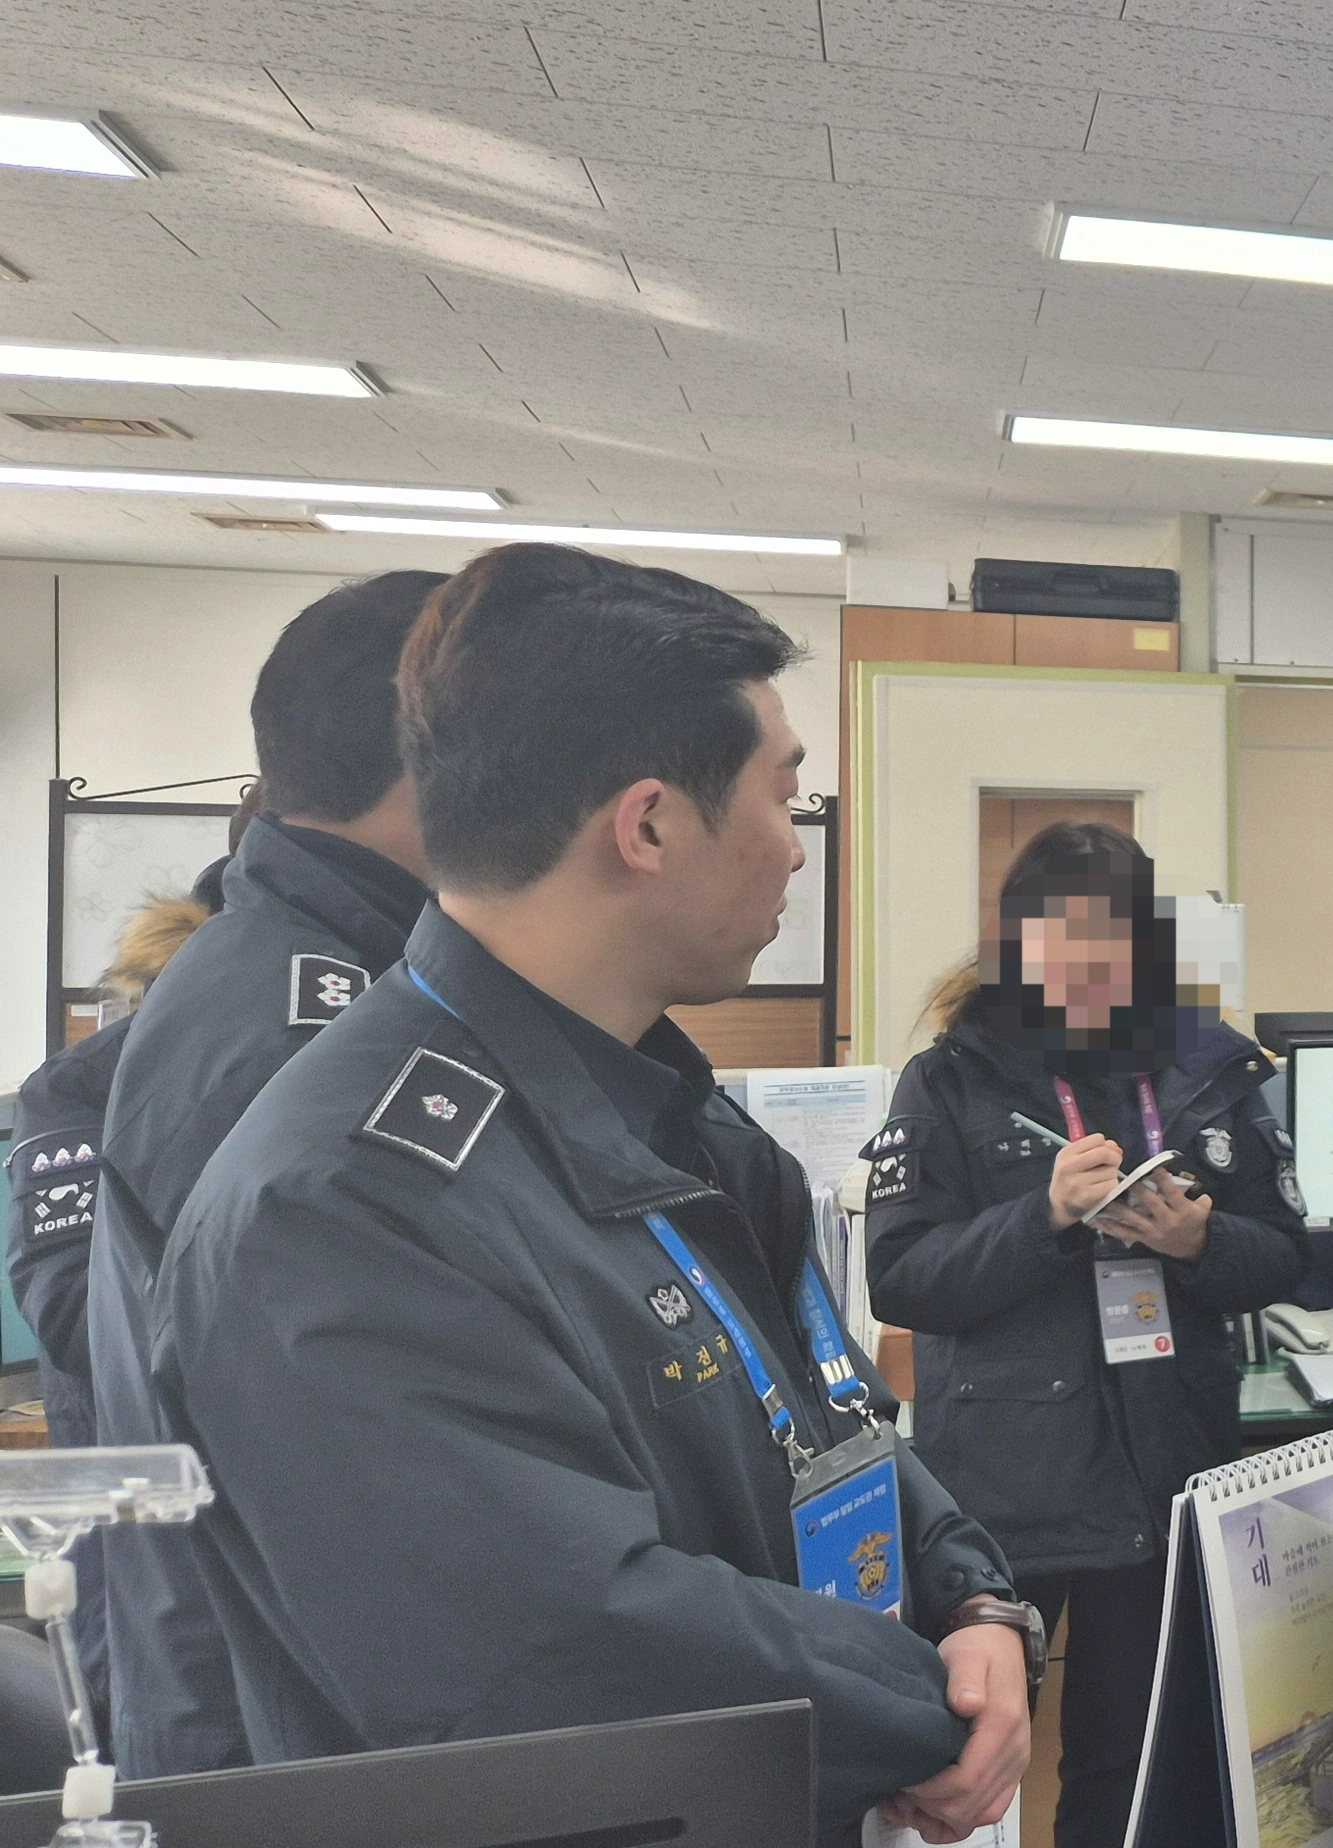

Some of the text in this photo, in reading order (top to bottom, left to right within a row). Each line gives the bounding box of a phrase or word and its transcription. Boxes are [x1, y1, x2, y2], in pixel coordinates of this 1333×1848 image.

[872, 1182, 907, 1200] KOREA
[34, 1211, 93, 1235] KOREA
[1158, 1338, 1165, 1348] 7
[696, 1362, 720, 1383] PARK
[1245, 1517, 1272, 1588] 기대
